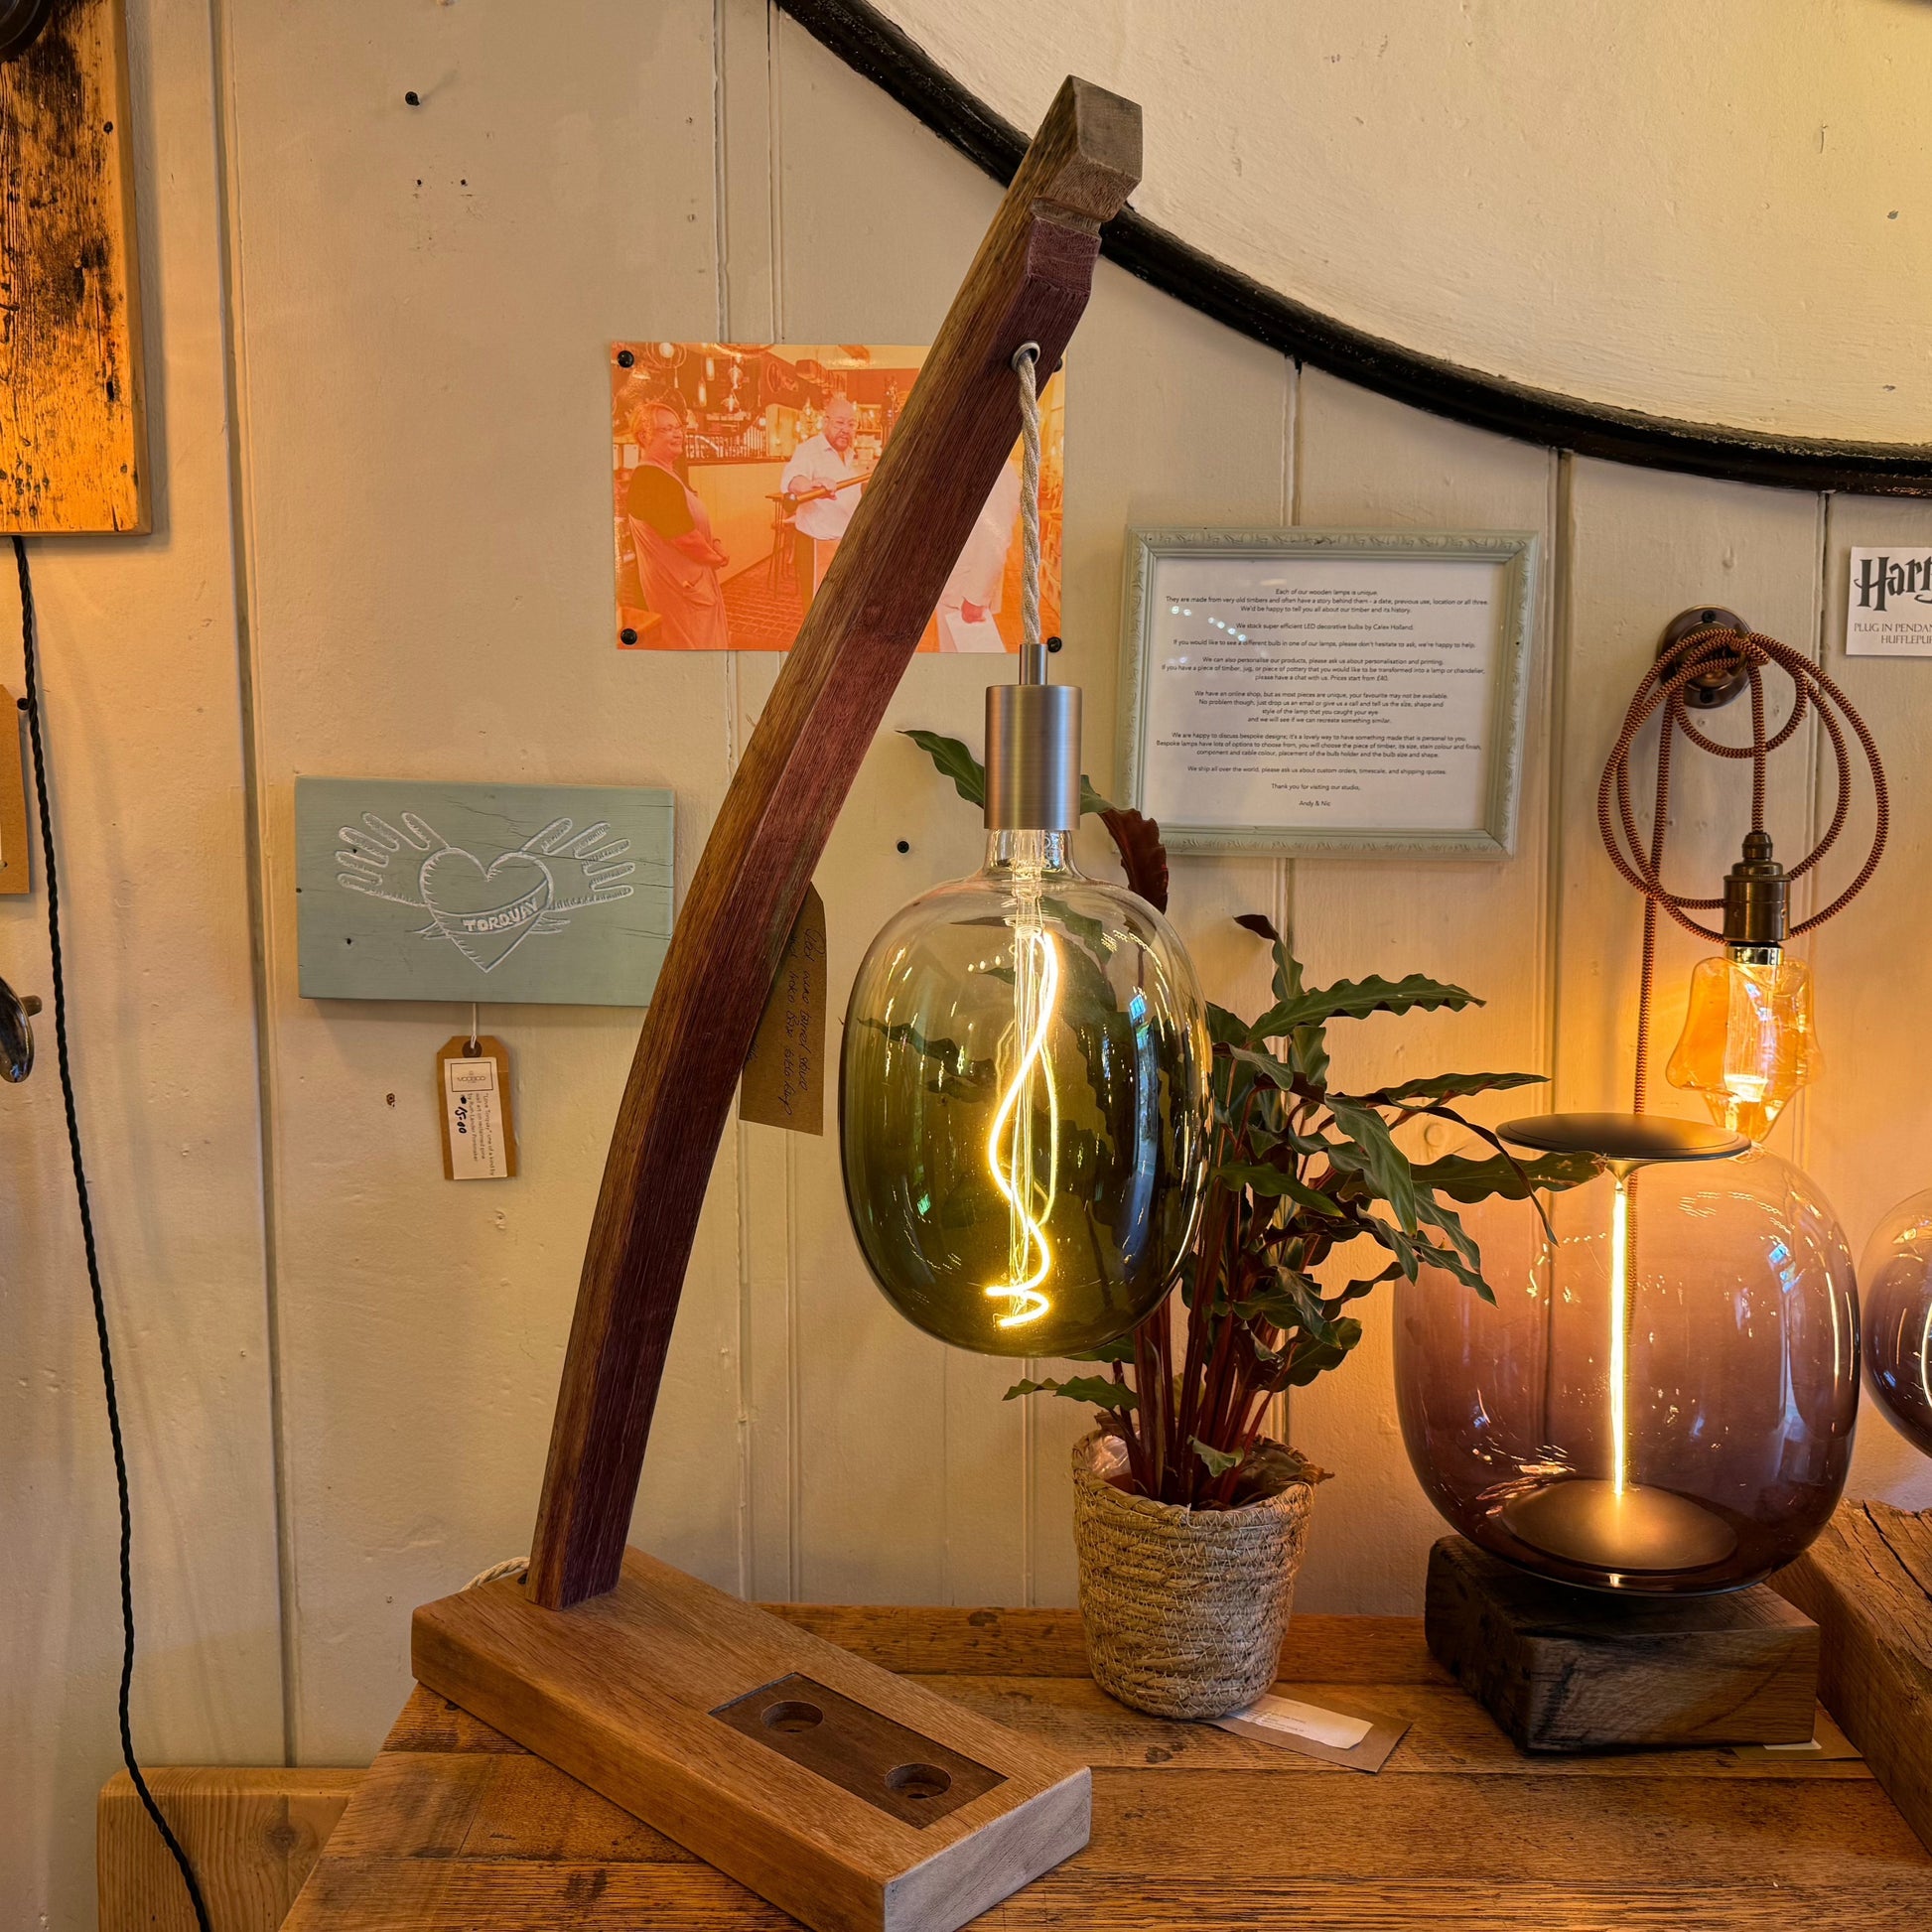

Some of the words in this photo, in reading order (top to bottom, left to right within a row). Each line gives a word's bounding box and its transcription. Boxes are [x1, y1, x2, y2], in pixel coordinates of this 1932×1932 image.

[1854, 622, 1879, 632] PLUG
[1882, 623, 1892, 632] IN
[462, 897, 538, 932] TORQUAY
[804, 928, 826, 962] Red
